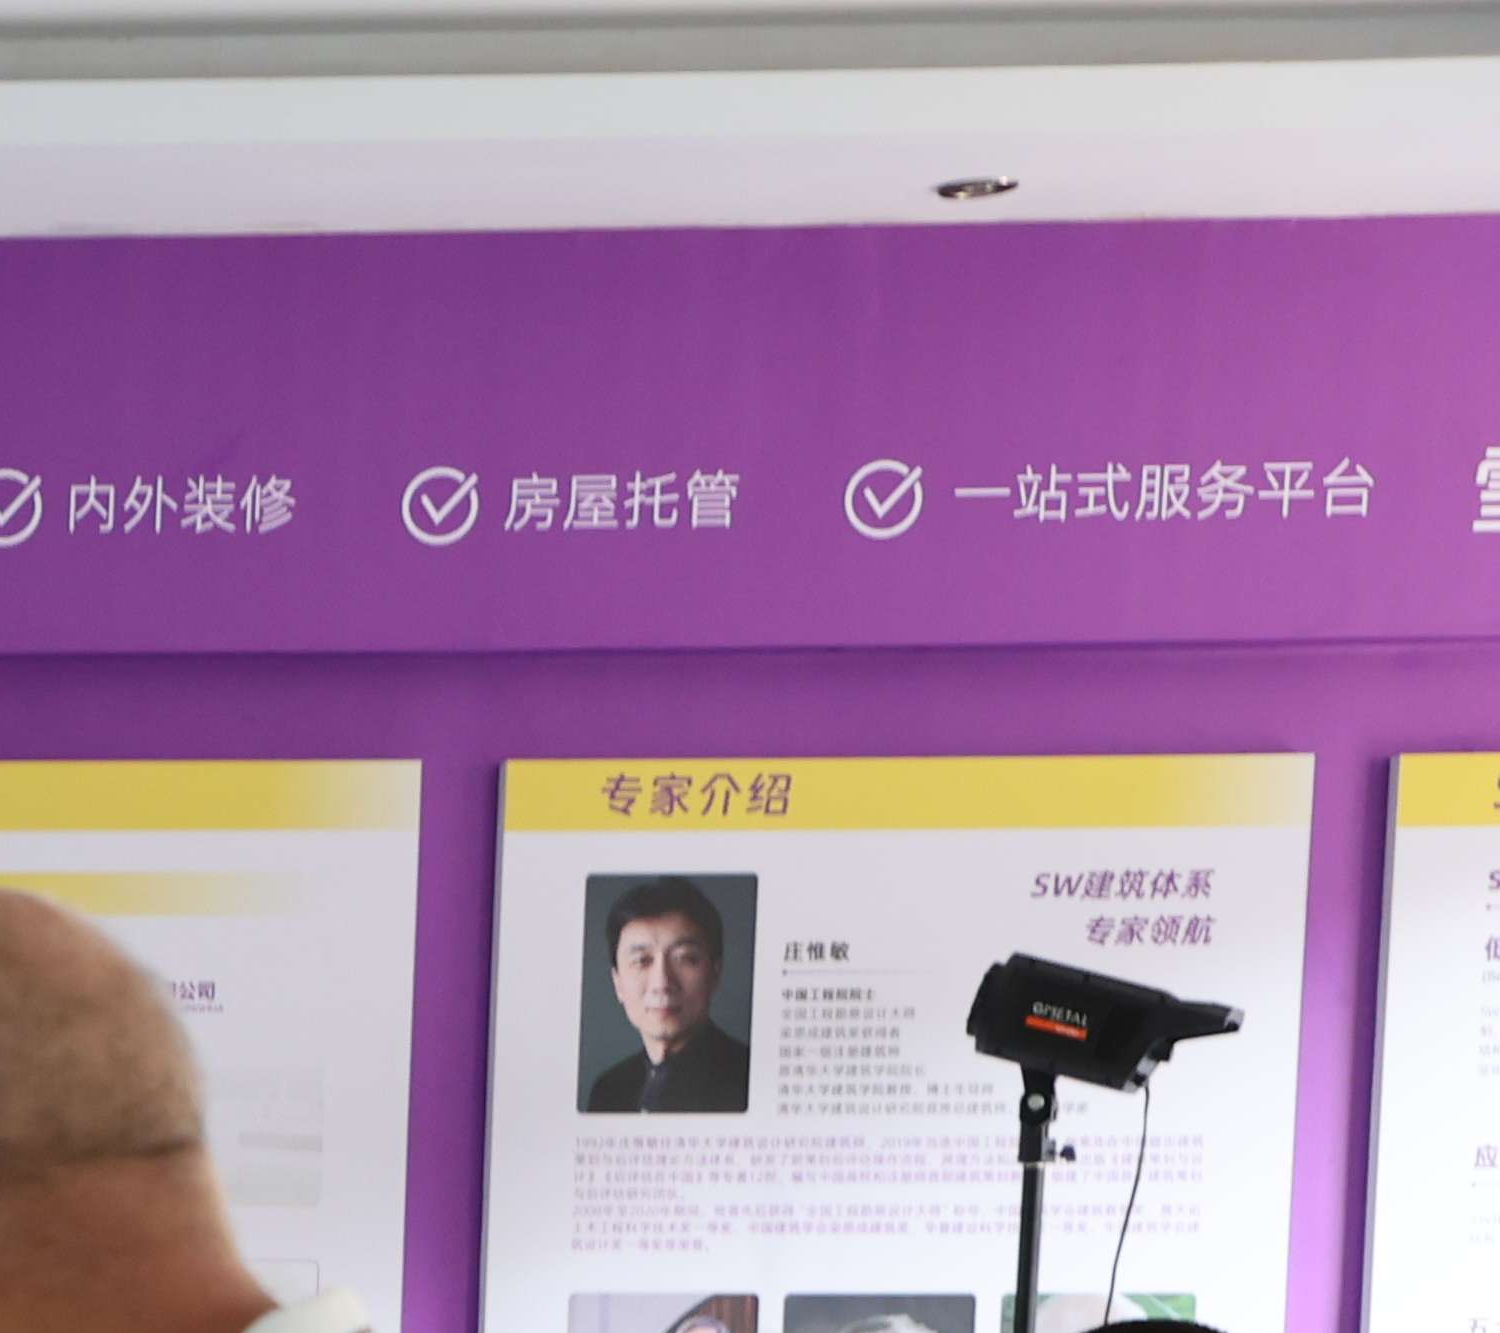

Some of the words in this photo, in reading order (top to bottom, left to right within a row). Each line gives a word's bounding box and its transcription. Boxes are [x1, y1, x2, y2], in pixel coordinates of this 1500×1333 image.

[67, 474, 297, 535] 内外装修
[503, 470, 741, 530] 房屋托管
[954, 457, 1375, 524] 一站式服务平台
[599, 773, 792, 817] 专家介绍
[1030, 868, 1216, 900] SW建筑体系
[783, 941, 851, 963] 庄惟敏
[1085, 915, 1216, 946] 专家领航
